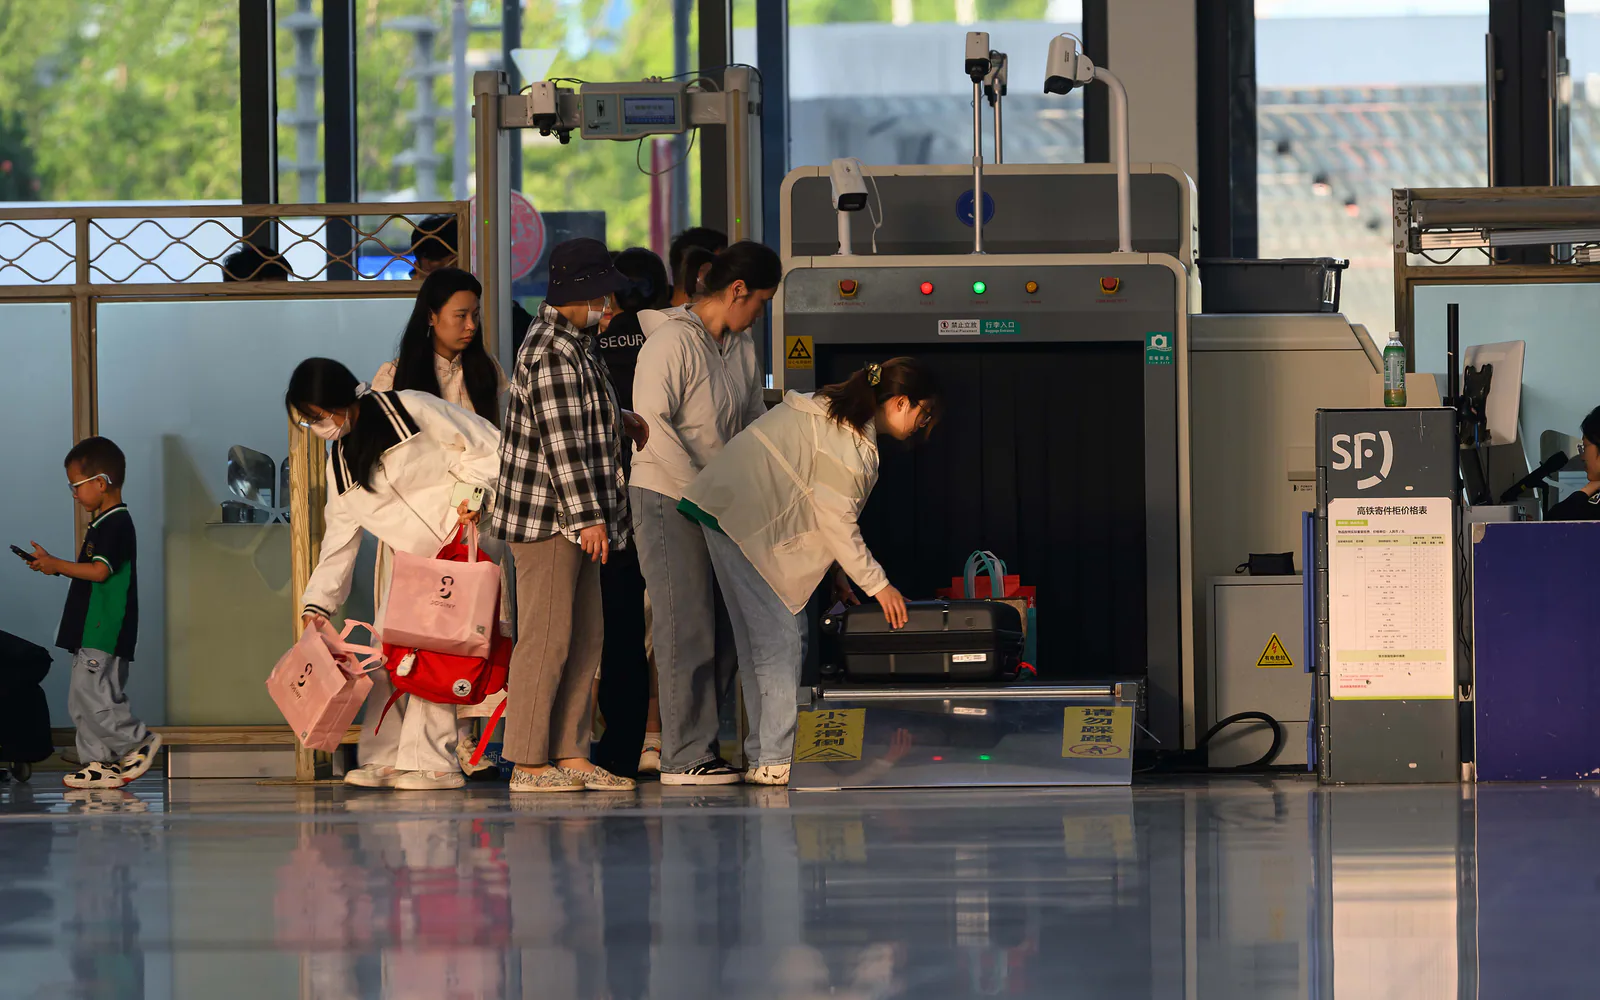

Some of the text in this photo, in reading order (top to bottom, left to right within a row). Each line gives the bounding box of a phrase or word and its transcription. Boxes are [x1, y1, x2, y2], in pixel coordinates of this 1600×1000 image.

[951, 321, 978, 329] 禁止立放
[985, 321, 1015, 329] 行李入口
[600, 334, 644, 349] SECUR
[1356, 505, 1428, 516] 高铁寄件柜价格表
[812, 711, 848, 747] 小心滑倒
[1080, 708, 1115, 744] 请勿踩踏
